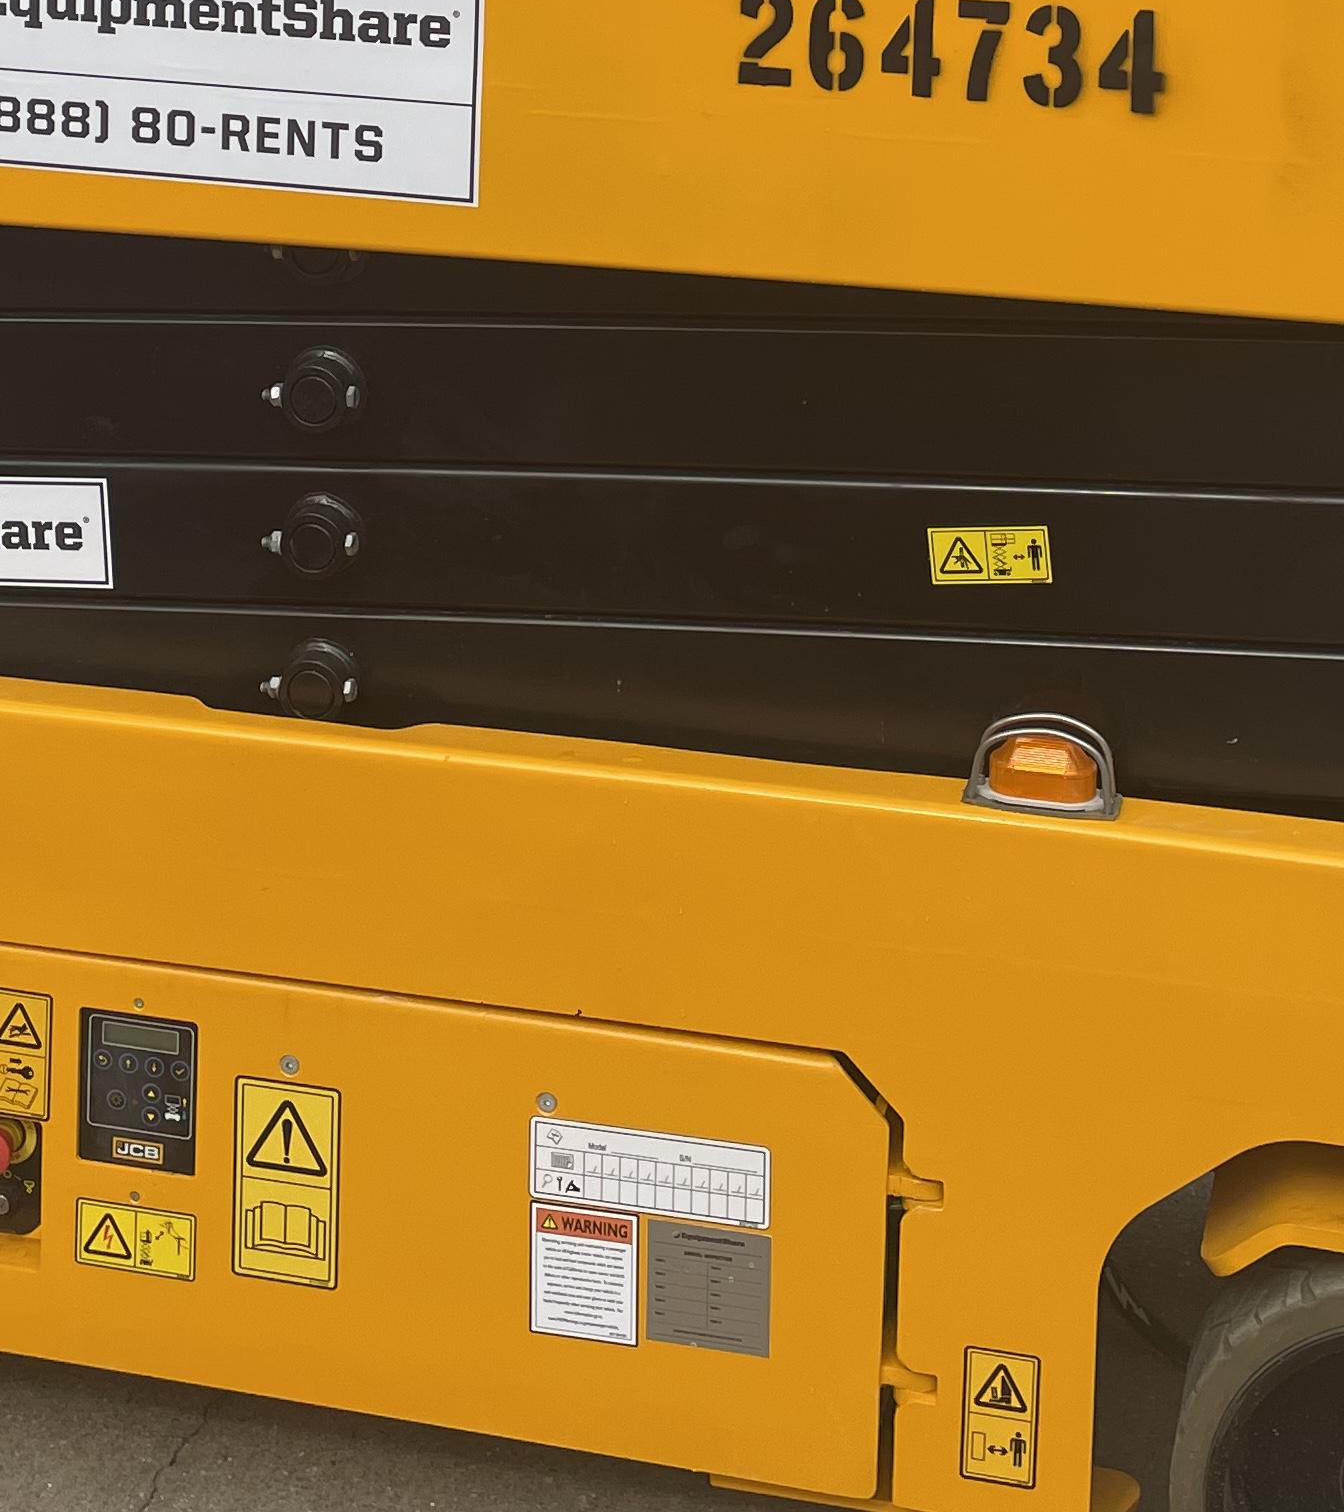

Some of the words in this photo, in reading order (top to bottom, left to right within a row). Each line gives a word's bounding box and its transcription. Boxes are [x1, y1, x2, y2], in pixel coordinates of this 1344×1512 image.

[131, 106, 384, 163] 80-RENTS
[117, 1142, 159, 1159] JCB
[588, 1142, 607, 1151] Model
[561, 1216, 628, 1238] WARNING
